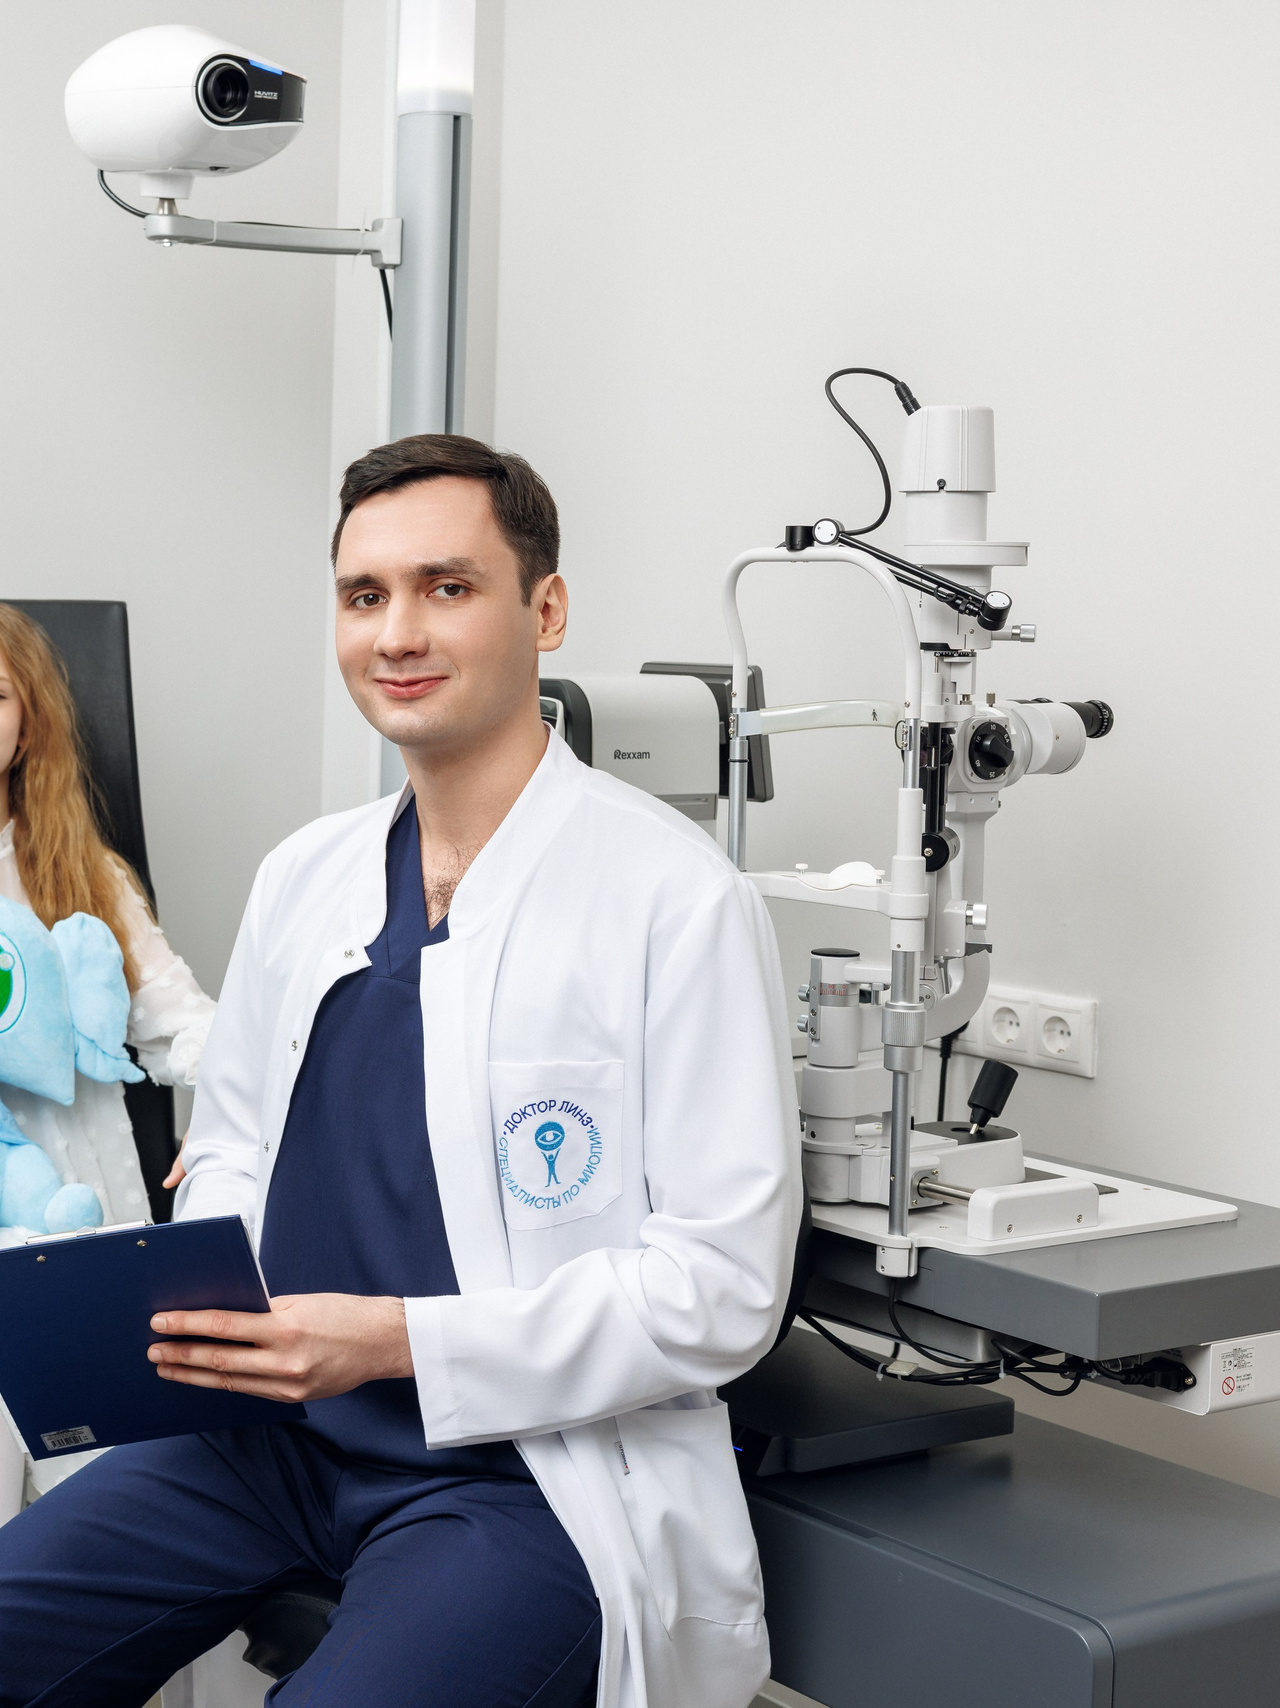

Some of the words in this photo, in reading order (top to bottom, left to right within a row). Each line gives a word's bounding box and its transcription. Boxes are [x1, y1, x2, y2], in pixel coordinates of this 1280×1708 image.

[613, 749, 651, 760] Rexxam
[503, 1099, 557, 1134] ДОКТОР
[558, 1100, 593, 1127] ЛИНЗ
[498, 1136, 561, 1210] СПЕЦИАЛИСТЫ
[562, 1184, 580, 1204] ПО
[577, 1127, 603, 1186] МИОПИИ
